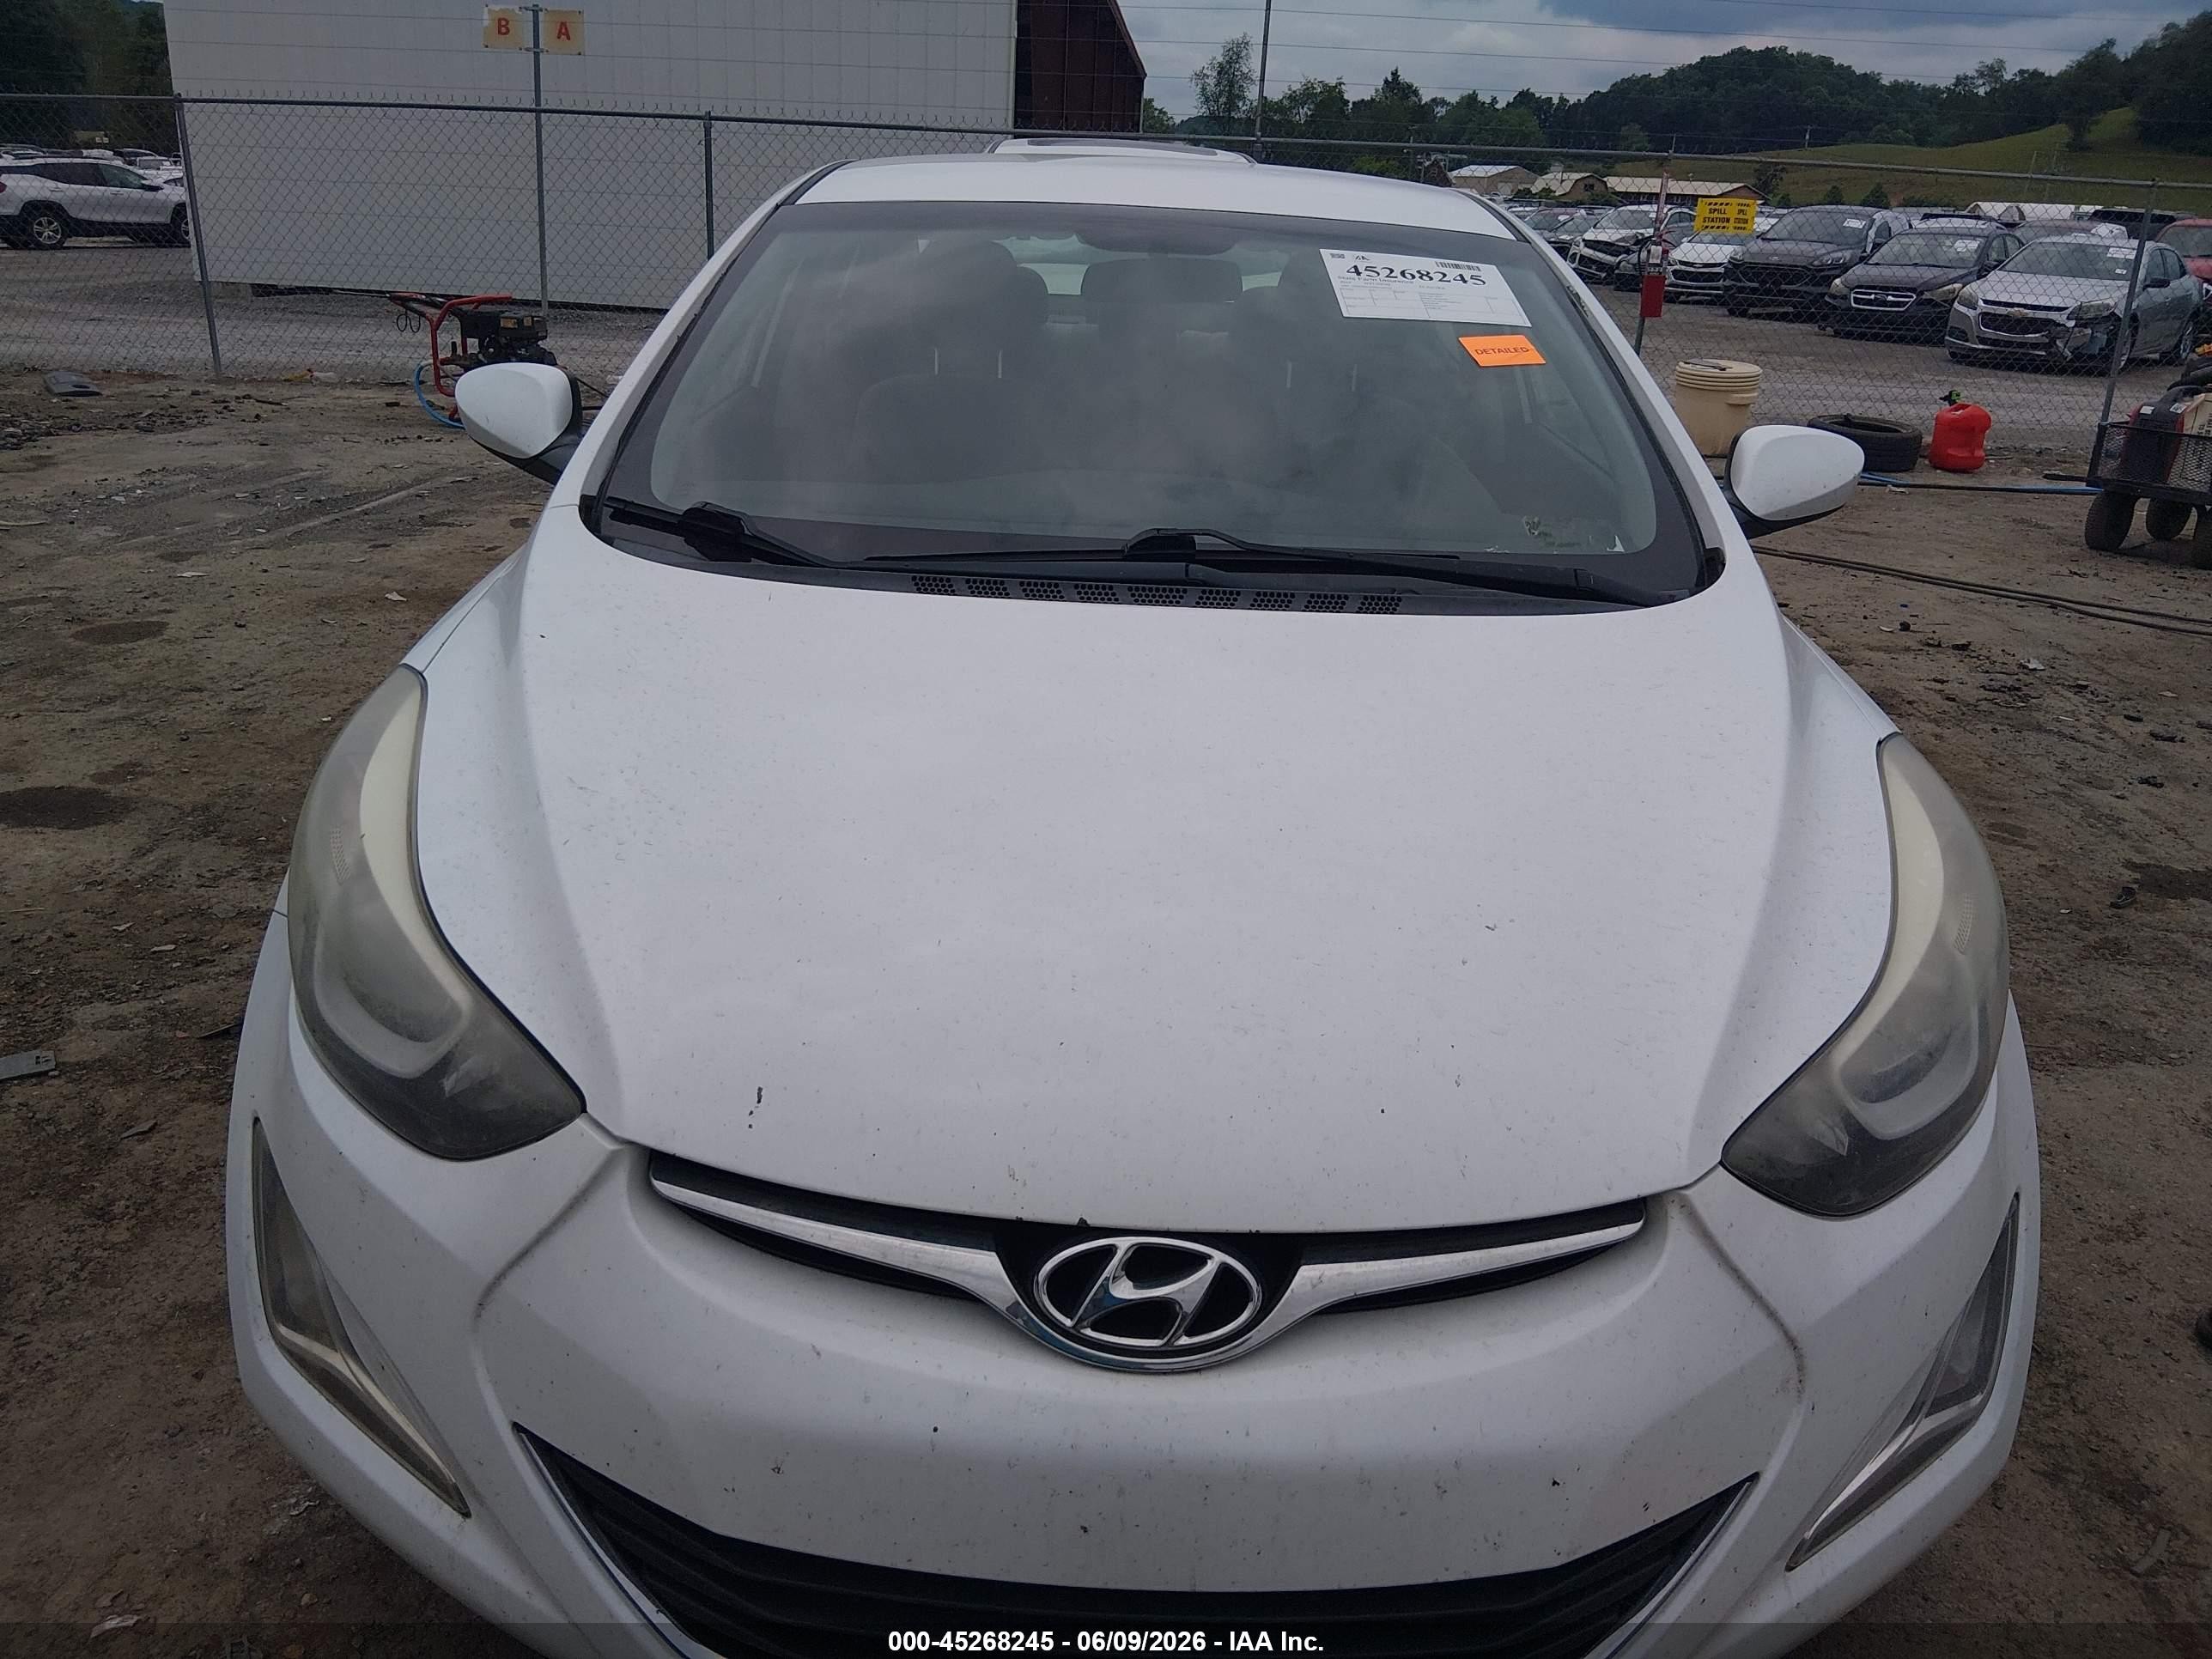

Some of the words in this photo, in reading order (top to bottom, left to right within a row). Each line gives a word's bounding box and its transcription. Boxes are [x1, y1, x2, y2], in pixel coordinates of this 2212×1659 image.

[497, 17, 510, 35] B
[556, 21, 571, 40] A
[1346, 264, 1486, 286] 45268245
